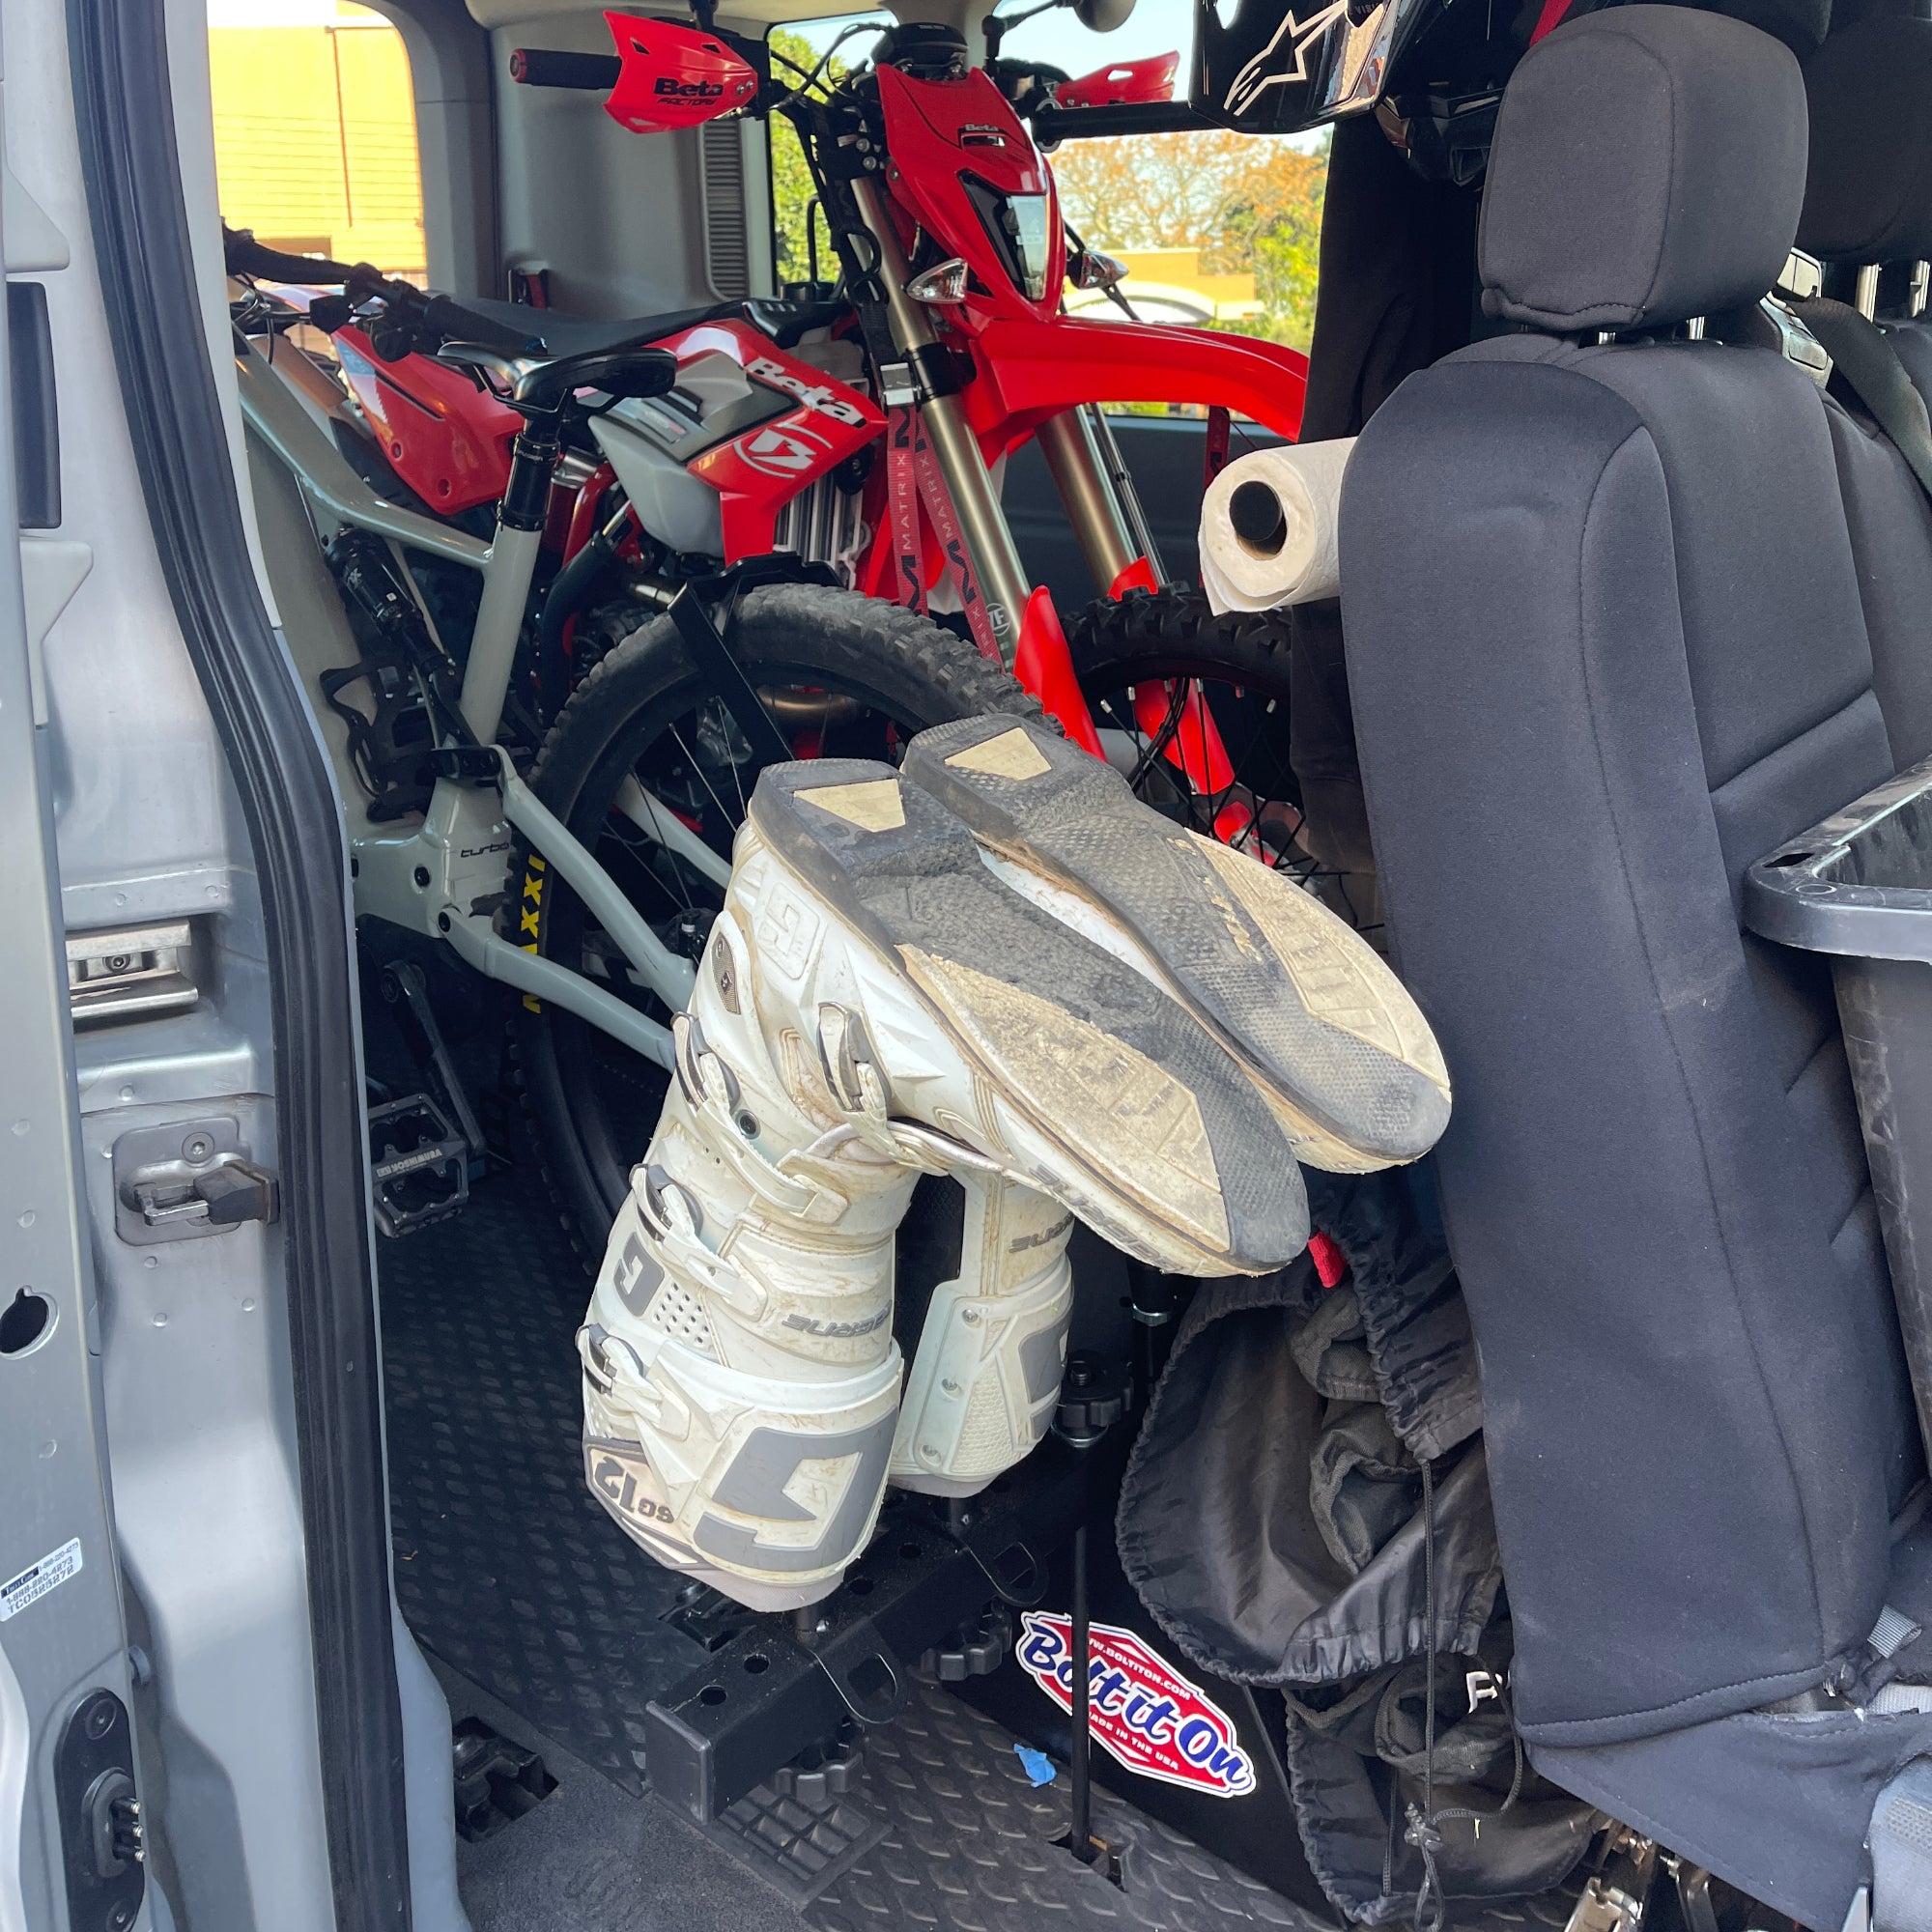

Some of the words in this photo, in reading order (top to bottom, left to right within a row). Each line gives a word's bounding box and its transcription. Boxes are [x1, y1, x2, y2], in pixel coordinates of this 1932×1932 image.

[654, 78, 724, 97] Beta
[746, 357, 866, 426] Beta
[897, 454, 912, 551] MATRIX
[920, 455, 952, 539] MATRIX
[461, 841, 510, 858] turbo
[391, 1149, 442, 1173] YOSHIMURA
[1089, 1712, 1114, 1732] ADE
[1116, 1728, 1128, 1741] IN
[1131, 1737, 1152, 1755] THE
[1155, 1751, 1179, 1771] USA
